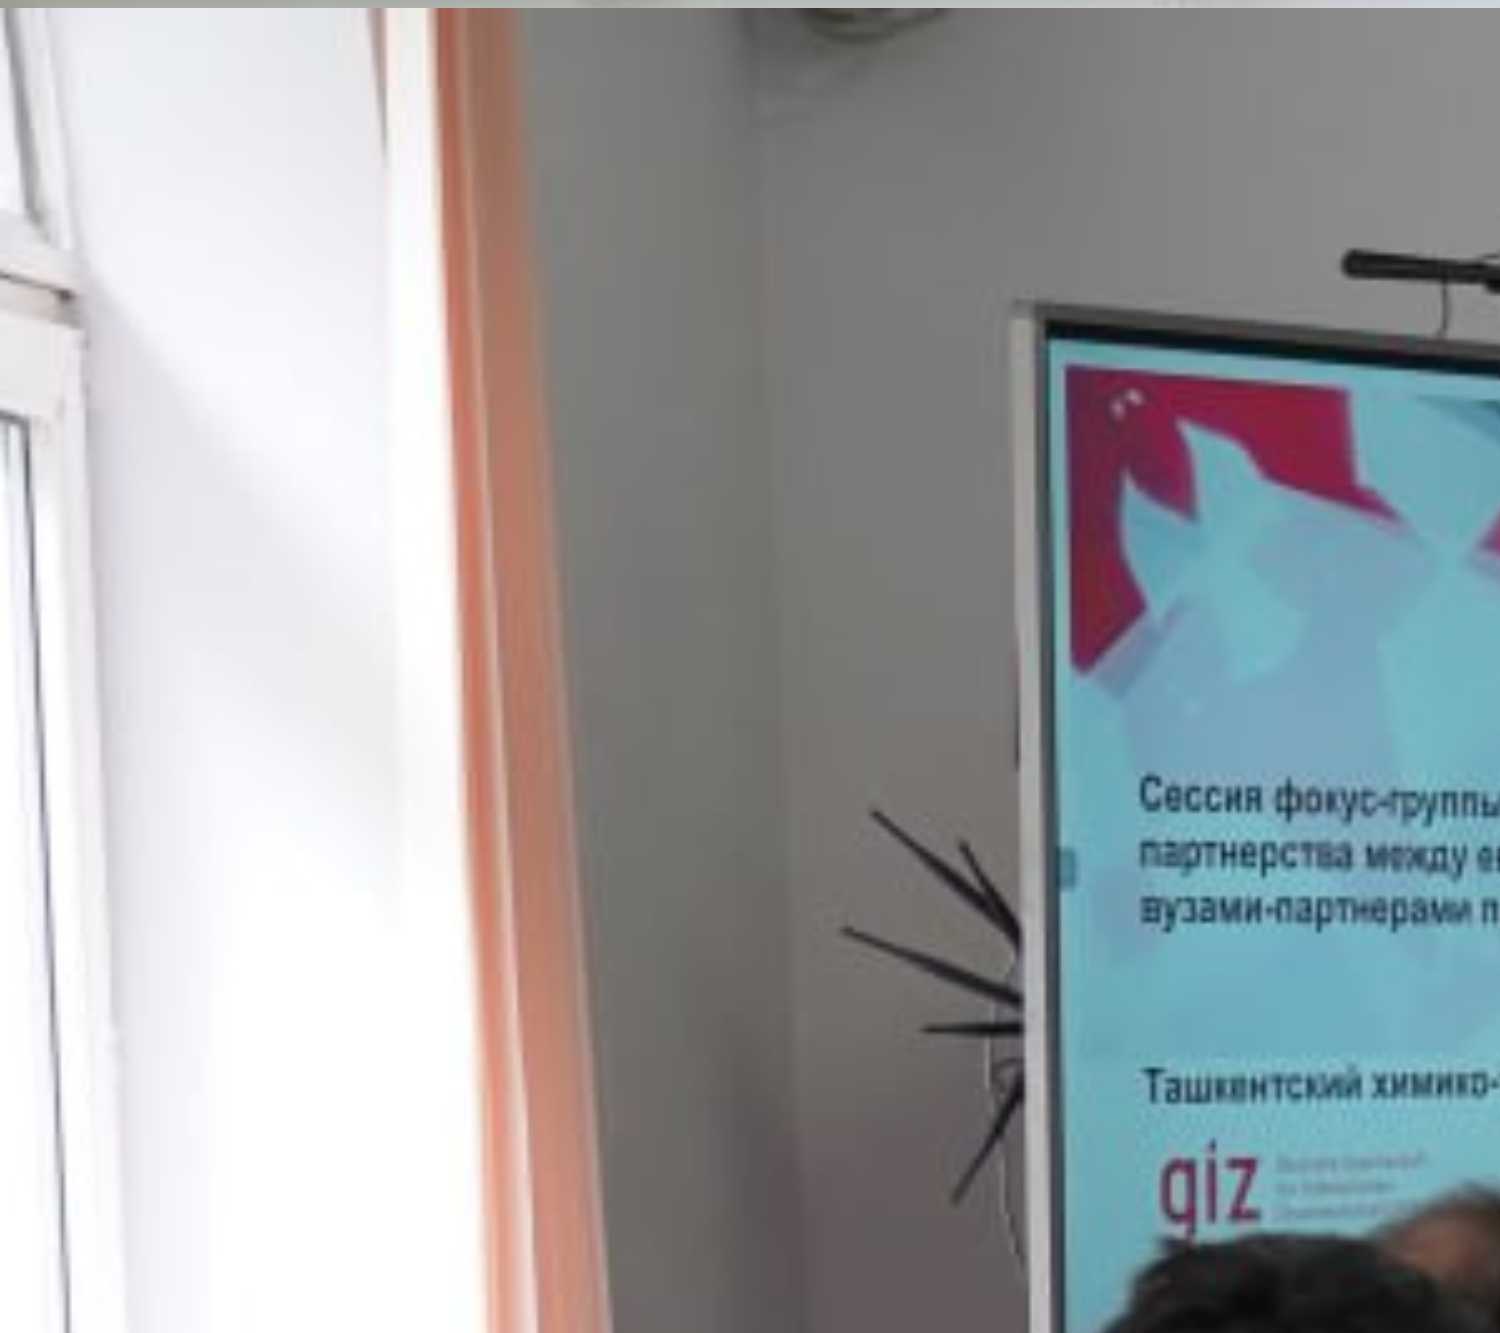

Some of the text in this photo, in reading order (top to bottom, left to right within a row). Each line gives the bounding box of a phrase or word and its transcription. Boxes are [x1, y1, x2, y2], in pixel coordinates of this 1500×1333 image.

[1139, 774, 1263, 814] Сессия
[1139, 838, 1354, 878] партнерства
[1366, 841, 1469, 882] между
[1139, 892, 1470, 934] вузами-партнерами
[1142, 1063, 1364, 1104] Ташкентский
[1159, 1138, 1261, 1240] giz
